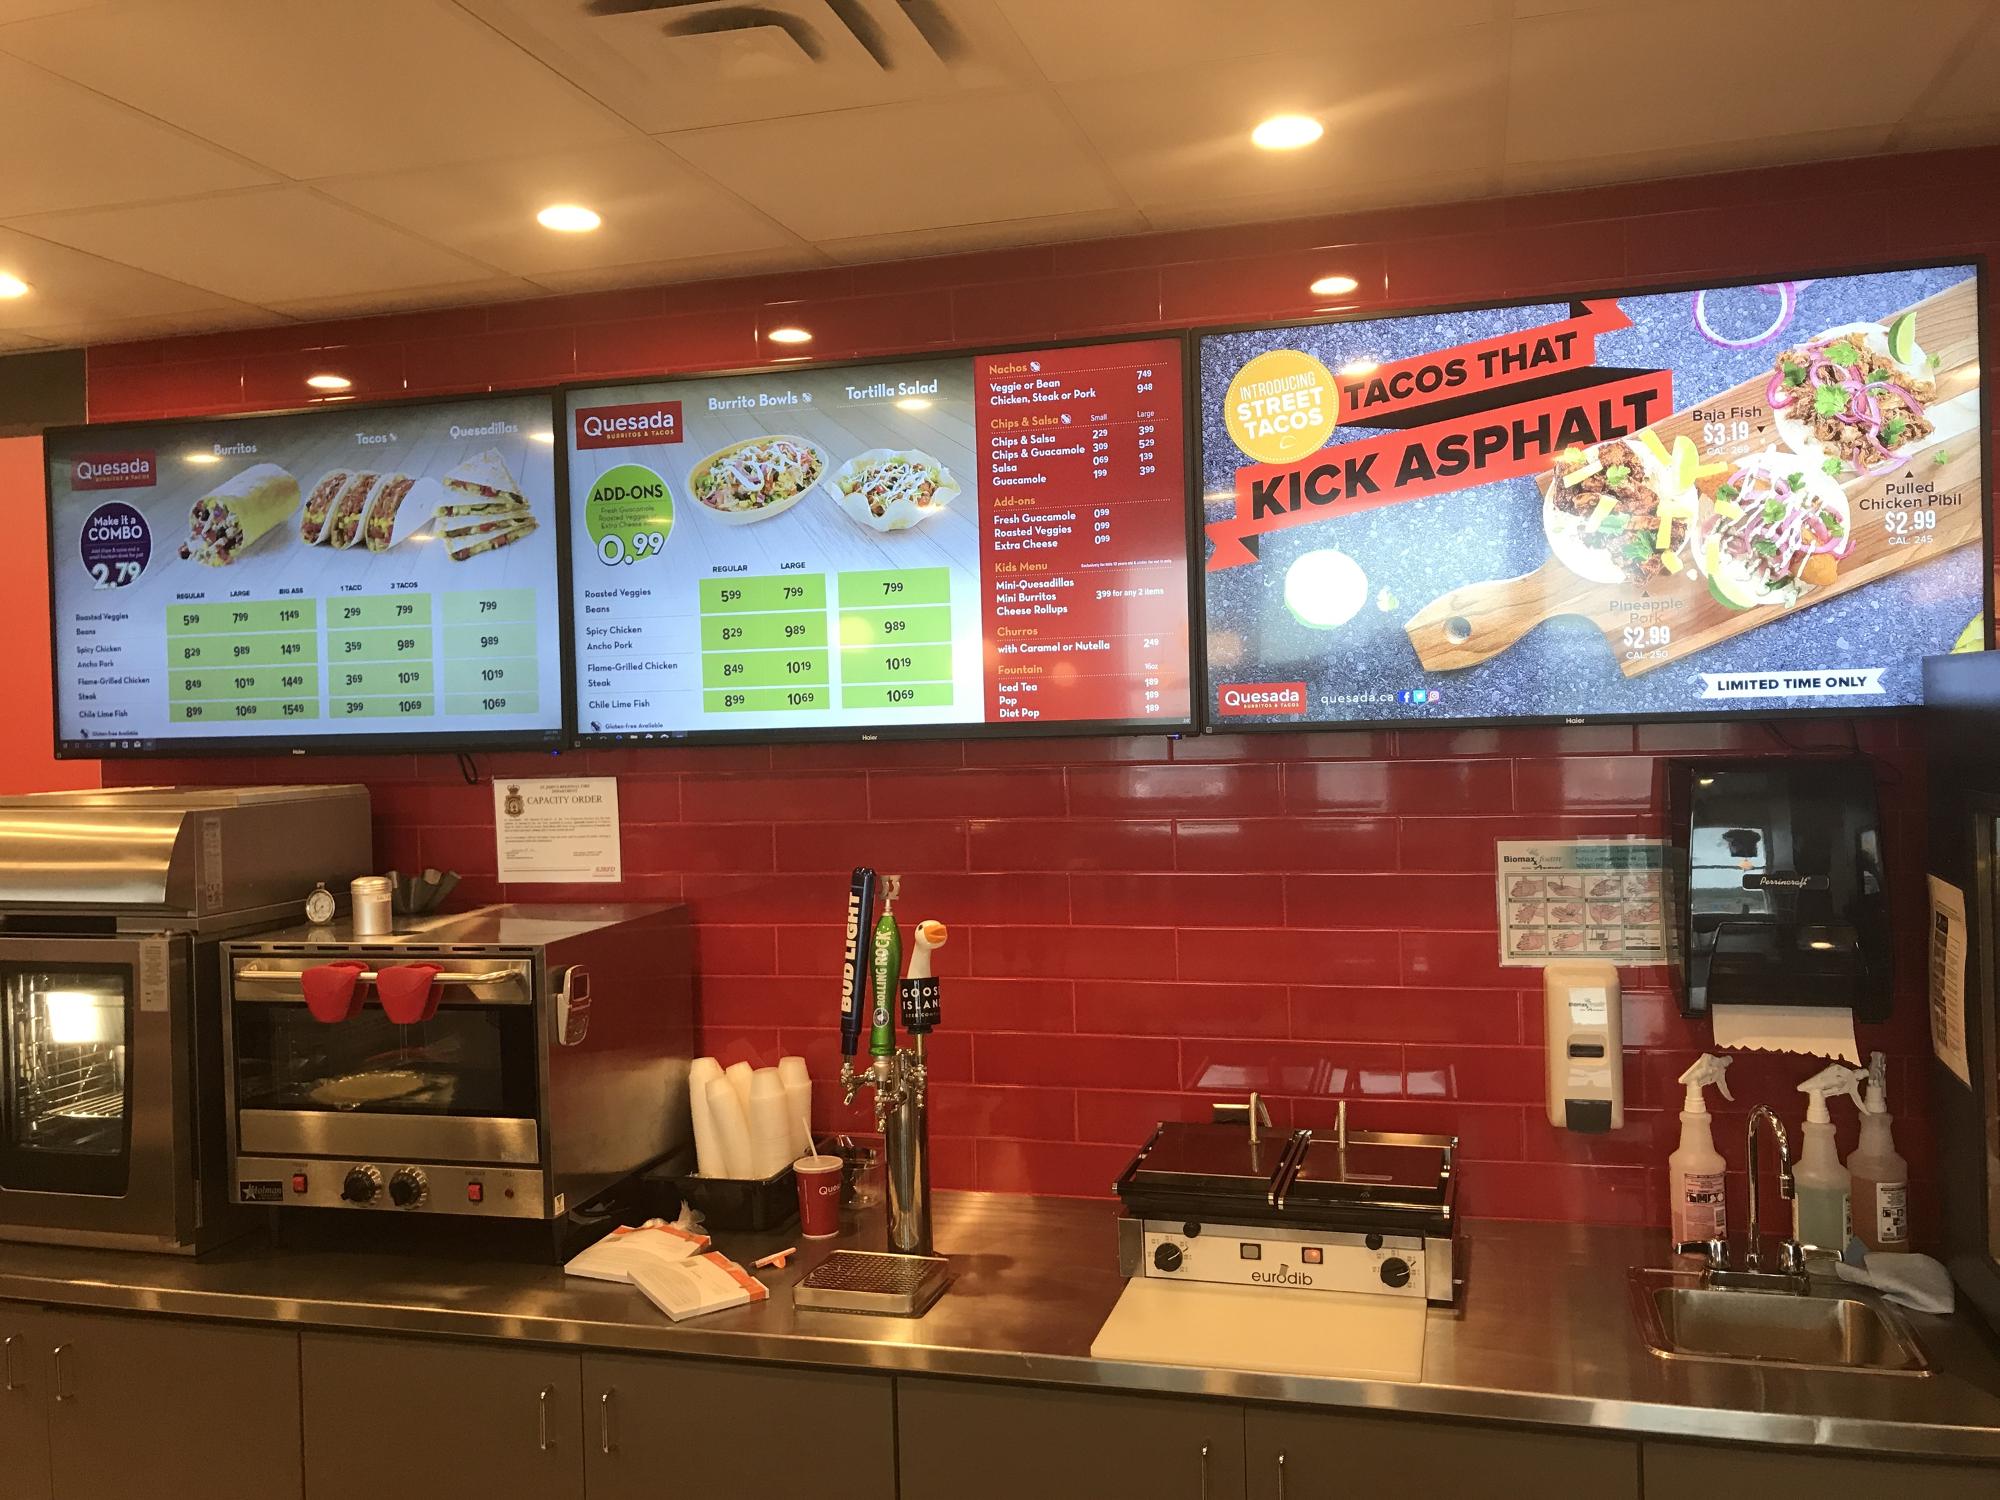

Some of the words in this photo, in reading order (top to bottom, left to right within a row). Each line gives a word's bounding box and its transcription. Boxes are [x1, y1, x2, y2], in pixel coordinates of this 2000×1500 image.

[989, 363, 1027, 374] Nachos
[1344, 359, 1468, 410] TACOS
[1478, 332, 1578, 379] THAT
[846, 384, 894, 400] Tortilla
[898, 379, 938, 396] Salad
[990, 382, 1022, 394] Veggie
[1024, 382, 1034, 390] or
[1036, 379, 1060, 388] Bean
[1239, 371, 1316, 400] INTRODUCING
[708, 396, 755, 410] Burrito
[760, 391, 798, 406] Bowls
[1032, 392, 1059, 402] Steak
[1074, 388, 1096, 398] Pork
[1236, 388, 1324, 422] STREET
[991, 418, 1019, 430] Chips
[1021, 418, 1029, 427] &
[1032, 414, 1059, 426] Salsa
[1090, 413, 1108, 422] Small
[1137, 410, 1154, 420] Large
[1692, 409, 1725, 423] Baja
[1730, 406, 1762, 418] Fish
[450, 422, 518, 440] Quesadillas
[584, 411, 674, 437] Quesada
[1244, 409, 1324, 440] TACOS
[356, 432, 387, 445] Tacos
[606, 432, 642, 440] BURRITOS
[1704, 420, 1749, 445] $3.19
[992, 436, 1018, 448] Chips
[1021, 436, 1028, 444] &
[1030, 434, 1056, 444] Salsa
[214, 443, 257, 456] Burritos
[992, 450, 1018, 462] Chips
[1021, 449, 1028, 458] &
[1031, 444, 1085, 457] Guacamole
[1252, 453, 1381, 520] KICK
[1394, 389, 1658, 488] ASPHALT
[78, 458, 149, 479] Quesada
[992, 464, 1017, 473] Salsa
[992, 474, 1046, 486] Guacamole
[593, 484, 663, 501] ADD-ONS
[1886, 482, 1934, 495] Pulled
[994, 496, 1036, 507] Add-ons
[1860, 497, 1922, 510] Chicken
[1928, 494, 1962, 506] Pibil
[94, 517, 118, 526] Make
[121, 515, 128, 524] it
[994, 514, 1020, 524] Fresh
[1022, 511, 1076, 522] Guacamole
[1885, 510, 1936, 534] $2.99
[88, 526, 142, 540] COMBO
[994, 527, 1032, 538] Roasted
[1035, 524, 1072, 537] Veggies
[598, 532, 664, 566] 0.99
[995, 541, 1020, 550] Extra
[1022, 539, 1058, 549] Cheese
[712, 564, 748, 573] REGULAR
[780, 562, 806, 570] LARGE
[995, 562, 1017, 573] Kids
[1020, 562, 1048, 571] Menu
[92, 561, 141, 589] 2.79
[996, 578, 1074, 590] Mini-Quesadillas
[585, 589, 618, 599] Roasted
[620, 588, 651, 598] Veggies
[996, 594, 1017, 603] Mini
[1019, 592, 1056, 601] Burritos
[1113, 589, 1122, 597] for
[1124, 589, 1137, 598] any
[1138, 588, 1142, 596] 2
[1145, 587, 1164, 596] items
[586, 605, 610, 613] Beans
[996, 606, 1031, 616] Cheese
[1034, 604, 1068, 616] Rollups
[1610, 598, 1683, 612] Pineapple
[1630, 612, 1663, 624] Pork
[586, 626, 607, 636] Spicy
[610, 626, 642, 634] Chicken
[997, 626, 1038, 636] Churros
[1624, 626, 1670, 648] $2.99
[587, 642, 612, 650] Ancho
[615, 641, 633, 649] Pork
[998, 644, 1017, 653] with
[1020, 642, 1060, 653] Caramel
[1076, 641, 1110, 650] Nutella
[588, 663, 643, 672] Flame-Grilled
[645, 662, 678, 670] Chicken
[998, 665, 1042, 675] Fountain
[588, 679, 611, 687] Steak
[999, 683, 1018, 692] Iced
[1021, 683, 1037, 691] Tea
[1718, 678, 1779, 691] LIMITED
[1784, 677, 1821, 689] TIME
[1825, 675, 1867, 689] ONLY
[589, 700, 610, 709] Chile
[612, 700, 631, 708] Lime
[634, 699, 650, 708] Fish
[1000, 696, 1017, 707] Pop
[1224, 689, 1300, 706] Quesada
[1320, 691, 1395, 705] quesada.ca
[1000, 709, 1019, 718] Diet
[1022, 708, 1039, 718] Pop
[527, 795, 570, 805] CAPACITY
[572, 794, 603, 804] ORDER
[845, 892, 861, 961] LIGHT
[875, 928, 892, 966] ROCK
[841, 962, 855, 1012] BUD
[876, 966, 888, 1008] ROLLING
[903, 999, 940, 1010] ISLAN
[1252, 1271, 1312, 1285] eurodib
